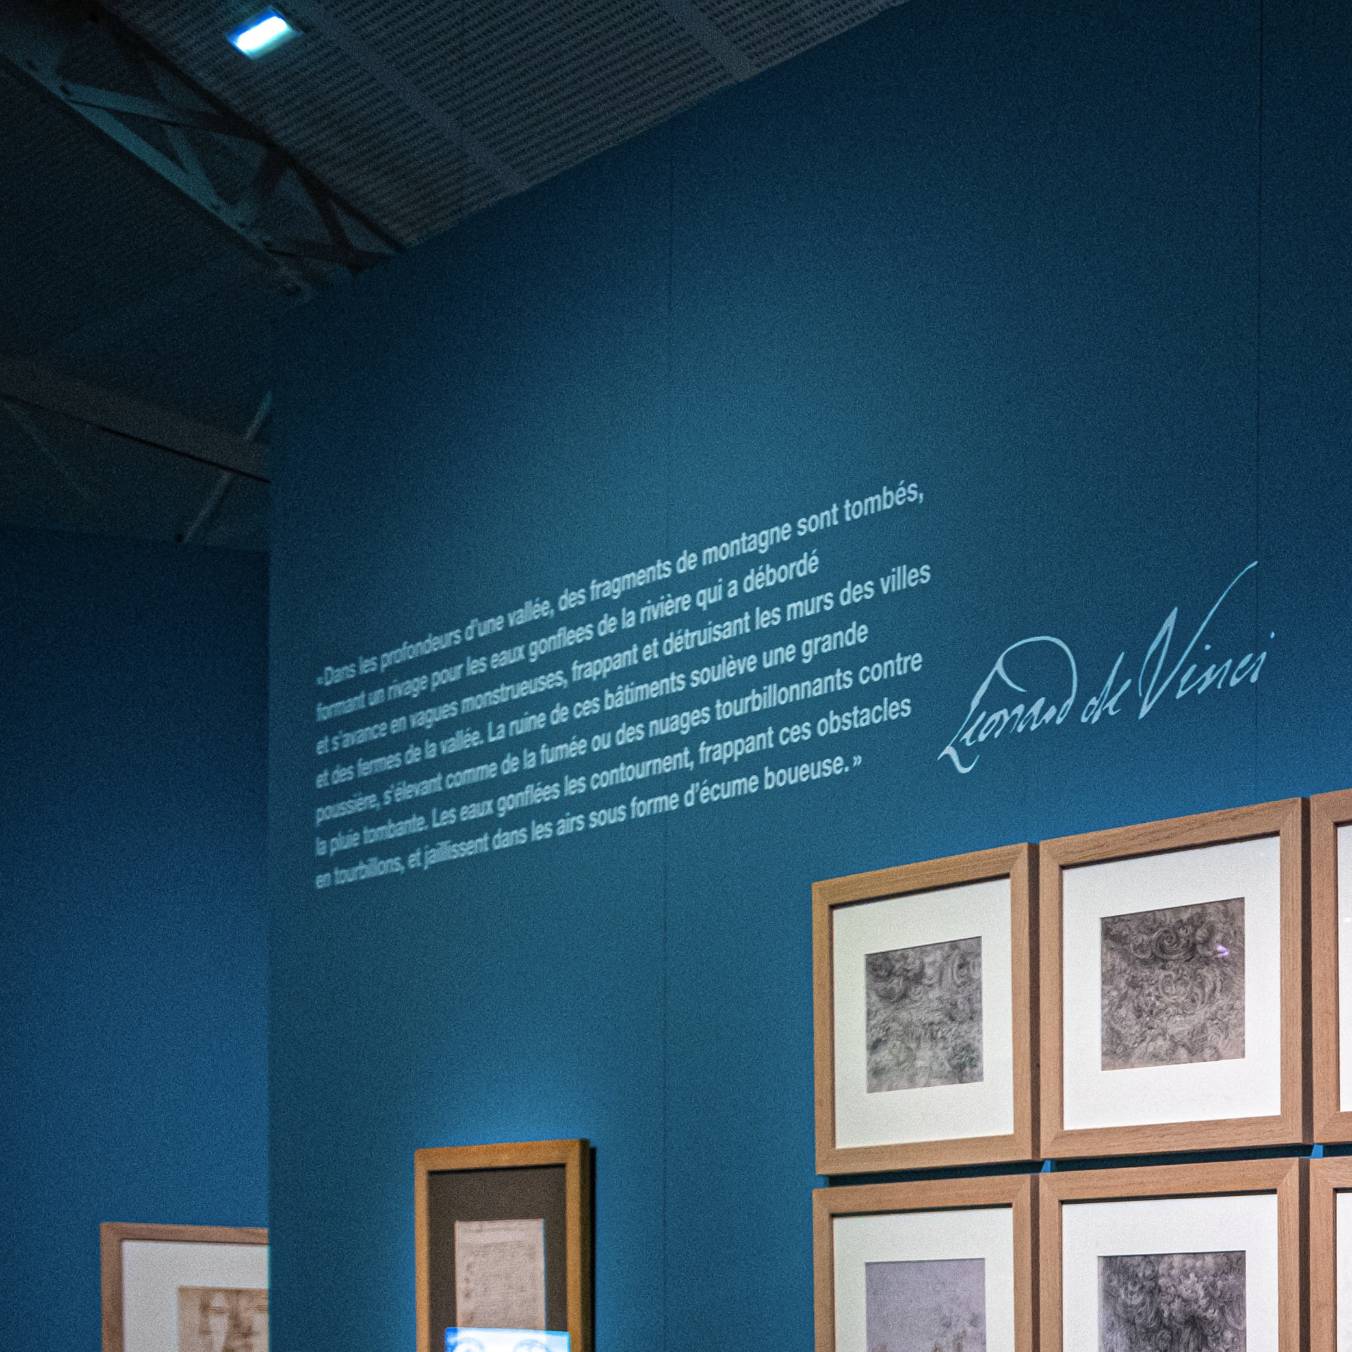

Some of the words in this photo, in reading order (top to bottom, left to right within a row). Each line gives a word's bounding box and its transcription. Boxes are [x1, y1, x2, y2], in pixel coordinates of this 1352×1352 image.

[316, 693, 365, 721] formant
[368, 688, 386, 707] un
[387, 680, 428, 700] rivage
[431, 664, 463, 692] pour
[466, 656, 487, 676] les
[490, 649, 526, 669] eaux
[597, 613, 618, 636] de
[621, 608, 635, 628] la
[640, 594, 692, 624] rivière
[696, 578, 723, 610] qui
[727, 580, 738, 598] a
[743, 549, 819, 594] débordé
[316, 737, 330, 755] et
[390, 716, 407, 735] en
[409, 701, 458, 729] vagues
[460, 669, 568, 714] monstrueuses,
[571, 645, 638, 681] frappant
[642, 639, 658, 662] et
[662, 612, 750, 656] détruisant
[755, 605, 781, 631] les
[786, 591, 834, 621] murs
[839, 580, 874, 606] des
[879, 563, 931, 595] villes
[358, 656, 378, 675] les
[380, 628, 461, 673] profondeurs
[507, 598, 554, 627] vallée,
[558, 588, 586, 611] des
[590, 559, 672, 601] fragments
[676, 550, 698, 574] de
[702, 523, 792, 566] montagne
[797, 505, 839, 536] sont
[843, 480, 924, 523] tombés,
[316, 771, 329, 788] et
[331, 765, 354, 784] des
[357, 751, 402, 778] fermes
[405, 745, 422, 765] de
[424, 739, 437, 758] la
[440, 727, 484, 755] vallée.
[488, 721, 506, 743] La
[508, 711, 546, 737] ruine
[550, 703, 569, 725] de
[573, 696, 600, 720] ces
[604, 672, 686, 711] bâtiments
[690, 652, 758, 687] soulève
[762, 643, 796, 669] une
[801, 621, 869, 663] grande
[316, 792, 380, 824] poussière,
[446, 761, 498, 790] comme
[501, 753, 519, 775] de
[523, 749, 536, 769] la
[540, 735, 587, 763] fumée
[591, 731, 611, 751] ou
[616, 723, 645, 746] des
[649, 706, 710, 737] nuages
[716, 669, 852, 721] tourbillonnants
[858, 652, 923, 685] contre
[1080, 651, 1132, 724] de
[315, 872, 331, 889] en
[334, 856, 405, 885] tourbillons,
[407, 851, 422, 870] et
[424, 833, 489, 870] jaillissent
[492, 826, 528, 850] dans
[531, 819, 552, 842] les
[556, 812, 586, 836] airs
[588, 805, 627, 828] sous
[630, 791, 680, 818] forme
[316, 837, 328, 856] la
[330, 831, 359, 856] pluie
[362, 814, 429, 843] tombante.
[432, 806, 457, 828] Les
[459, 799, 494, 821] eaux
[564, 773, 586, 796] les
[590, 748, 695, 790] contournent,
[699, 726, 774, 765] frappant
[778, 721, 811, 746] ces
[817, 697, 912, 737] obstacles
